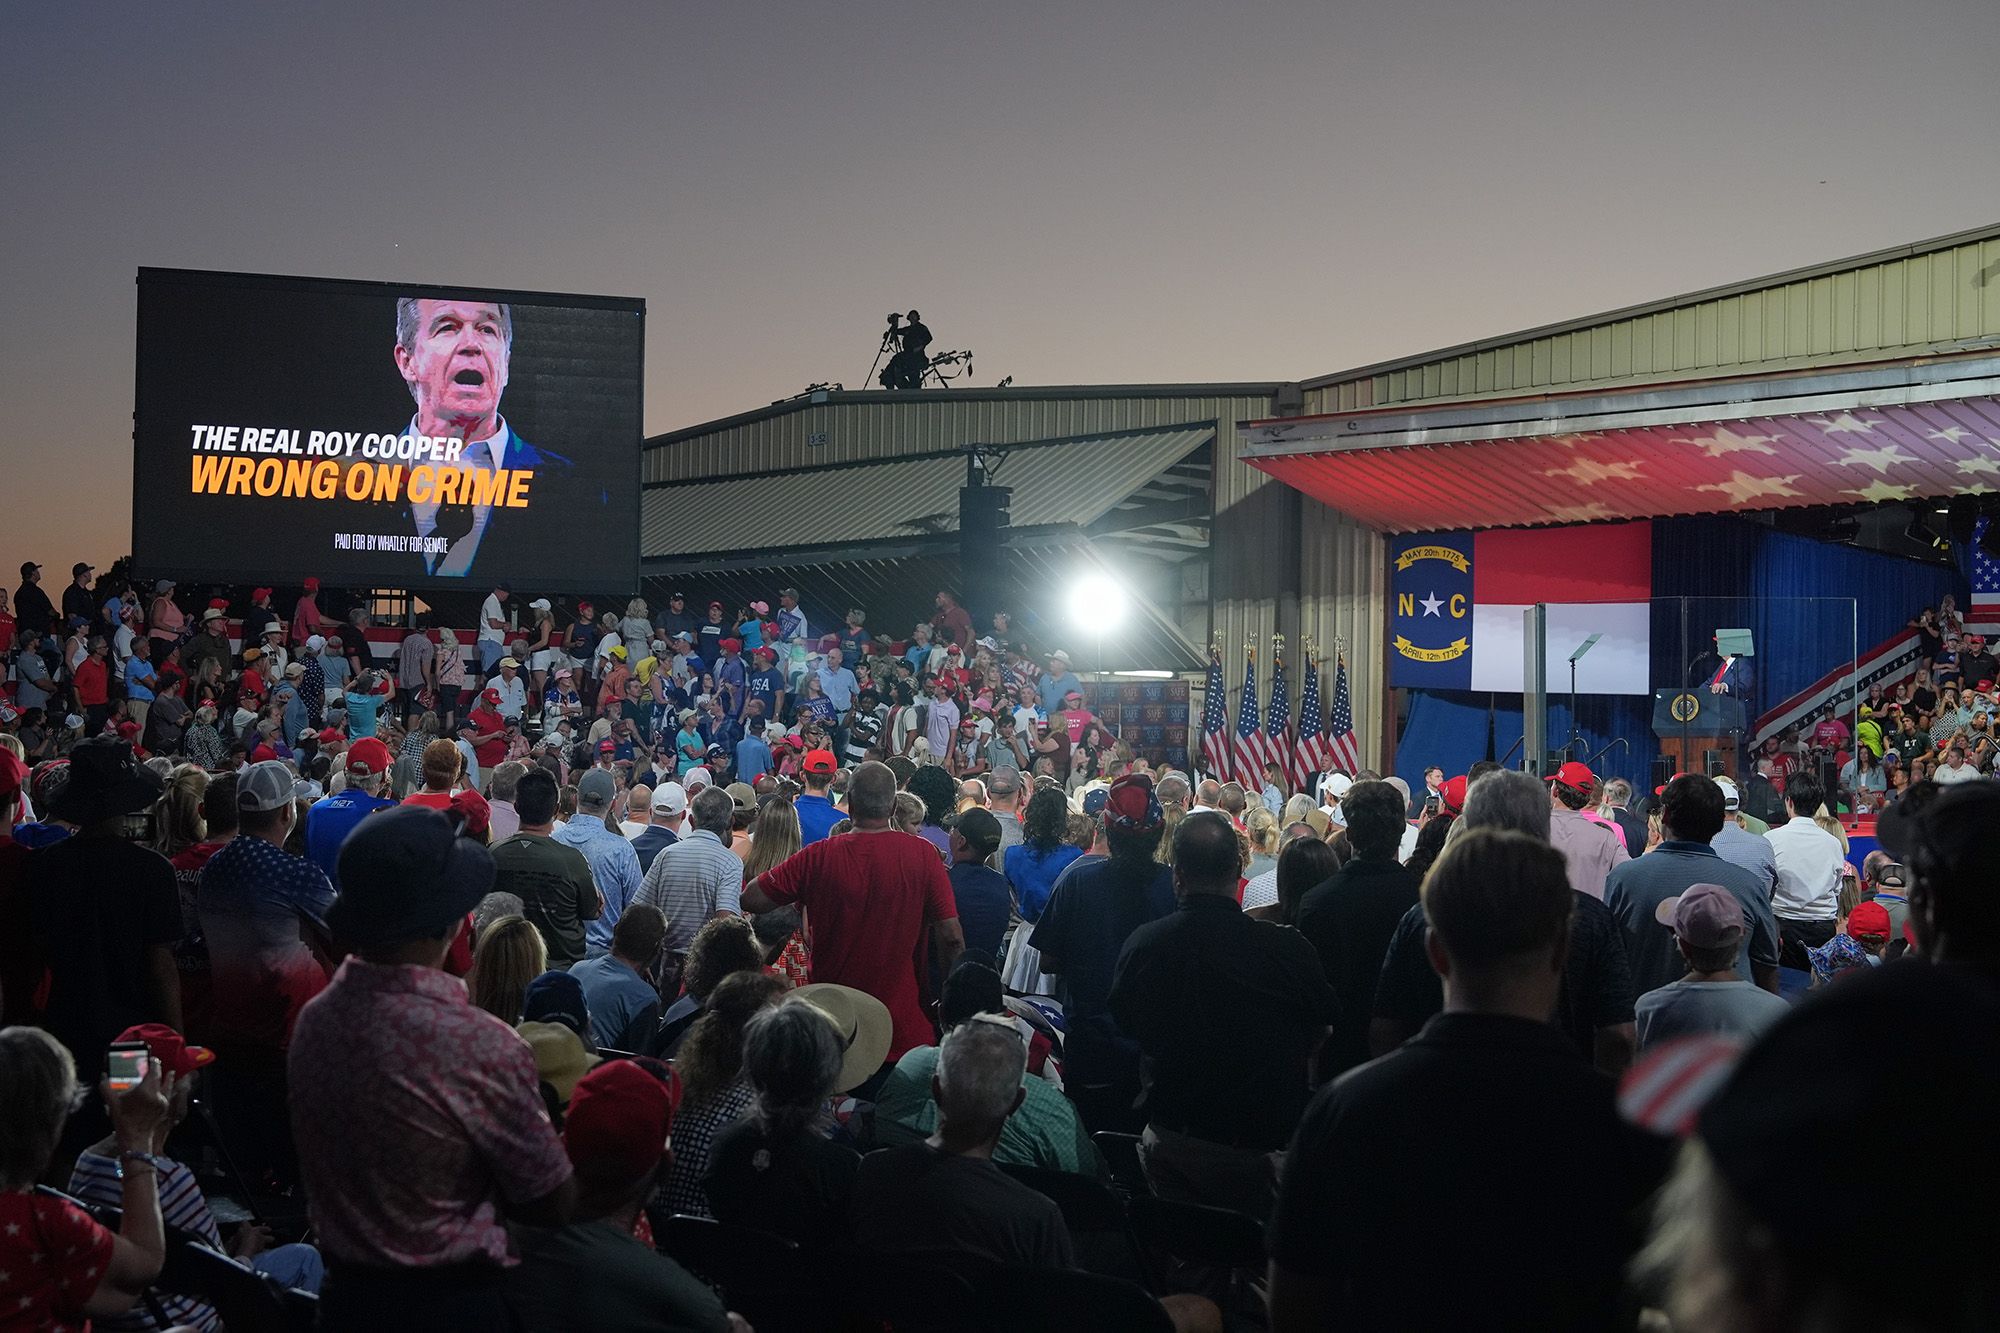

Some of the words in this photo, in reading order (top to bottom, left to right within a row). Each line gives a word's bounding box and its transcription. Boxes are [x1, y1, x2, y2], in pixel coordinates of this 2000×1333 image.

[191, 425, 240, 451] THE
[240, 427, 303, 455] REAL
[307, 430, 361, 457] ROY
[362, 433, 463, 462] COOPER
[192, 454, 340, 500] WRONG
[345, 461, 403, 502] ON
[407, 465, 534, 508] CRIME
[334, 533, 351, 550] PAID
[352, 533, 366, 550] FOR
[367, 534, 377, 551] BY
[377, 535, 409, 552] WHATLEY
[409, 536, 422, 553] FOR
[423, 536, 449, 554] SENATE
[1405, 549, 1421, 561] MAY
[1423, 548, 1440, 557] 20th
[1442, 549, 1460, 562] 1775
[1398, 592, 1414, 617] N
[1449, 592, 1467, 618] C
[1402, 645, 1424, 660] APRIL
[1426, 652, 1441, 661] 12th
[1442, 647, 1459, 660] 1776
[1169, 686, 1185, 697] SAFE
[811, 703, 829, 715] AFE
[1146, 708, 1162, 719] SAFE
[1169, 708, 1185, 719] SAFE
